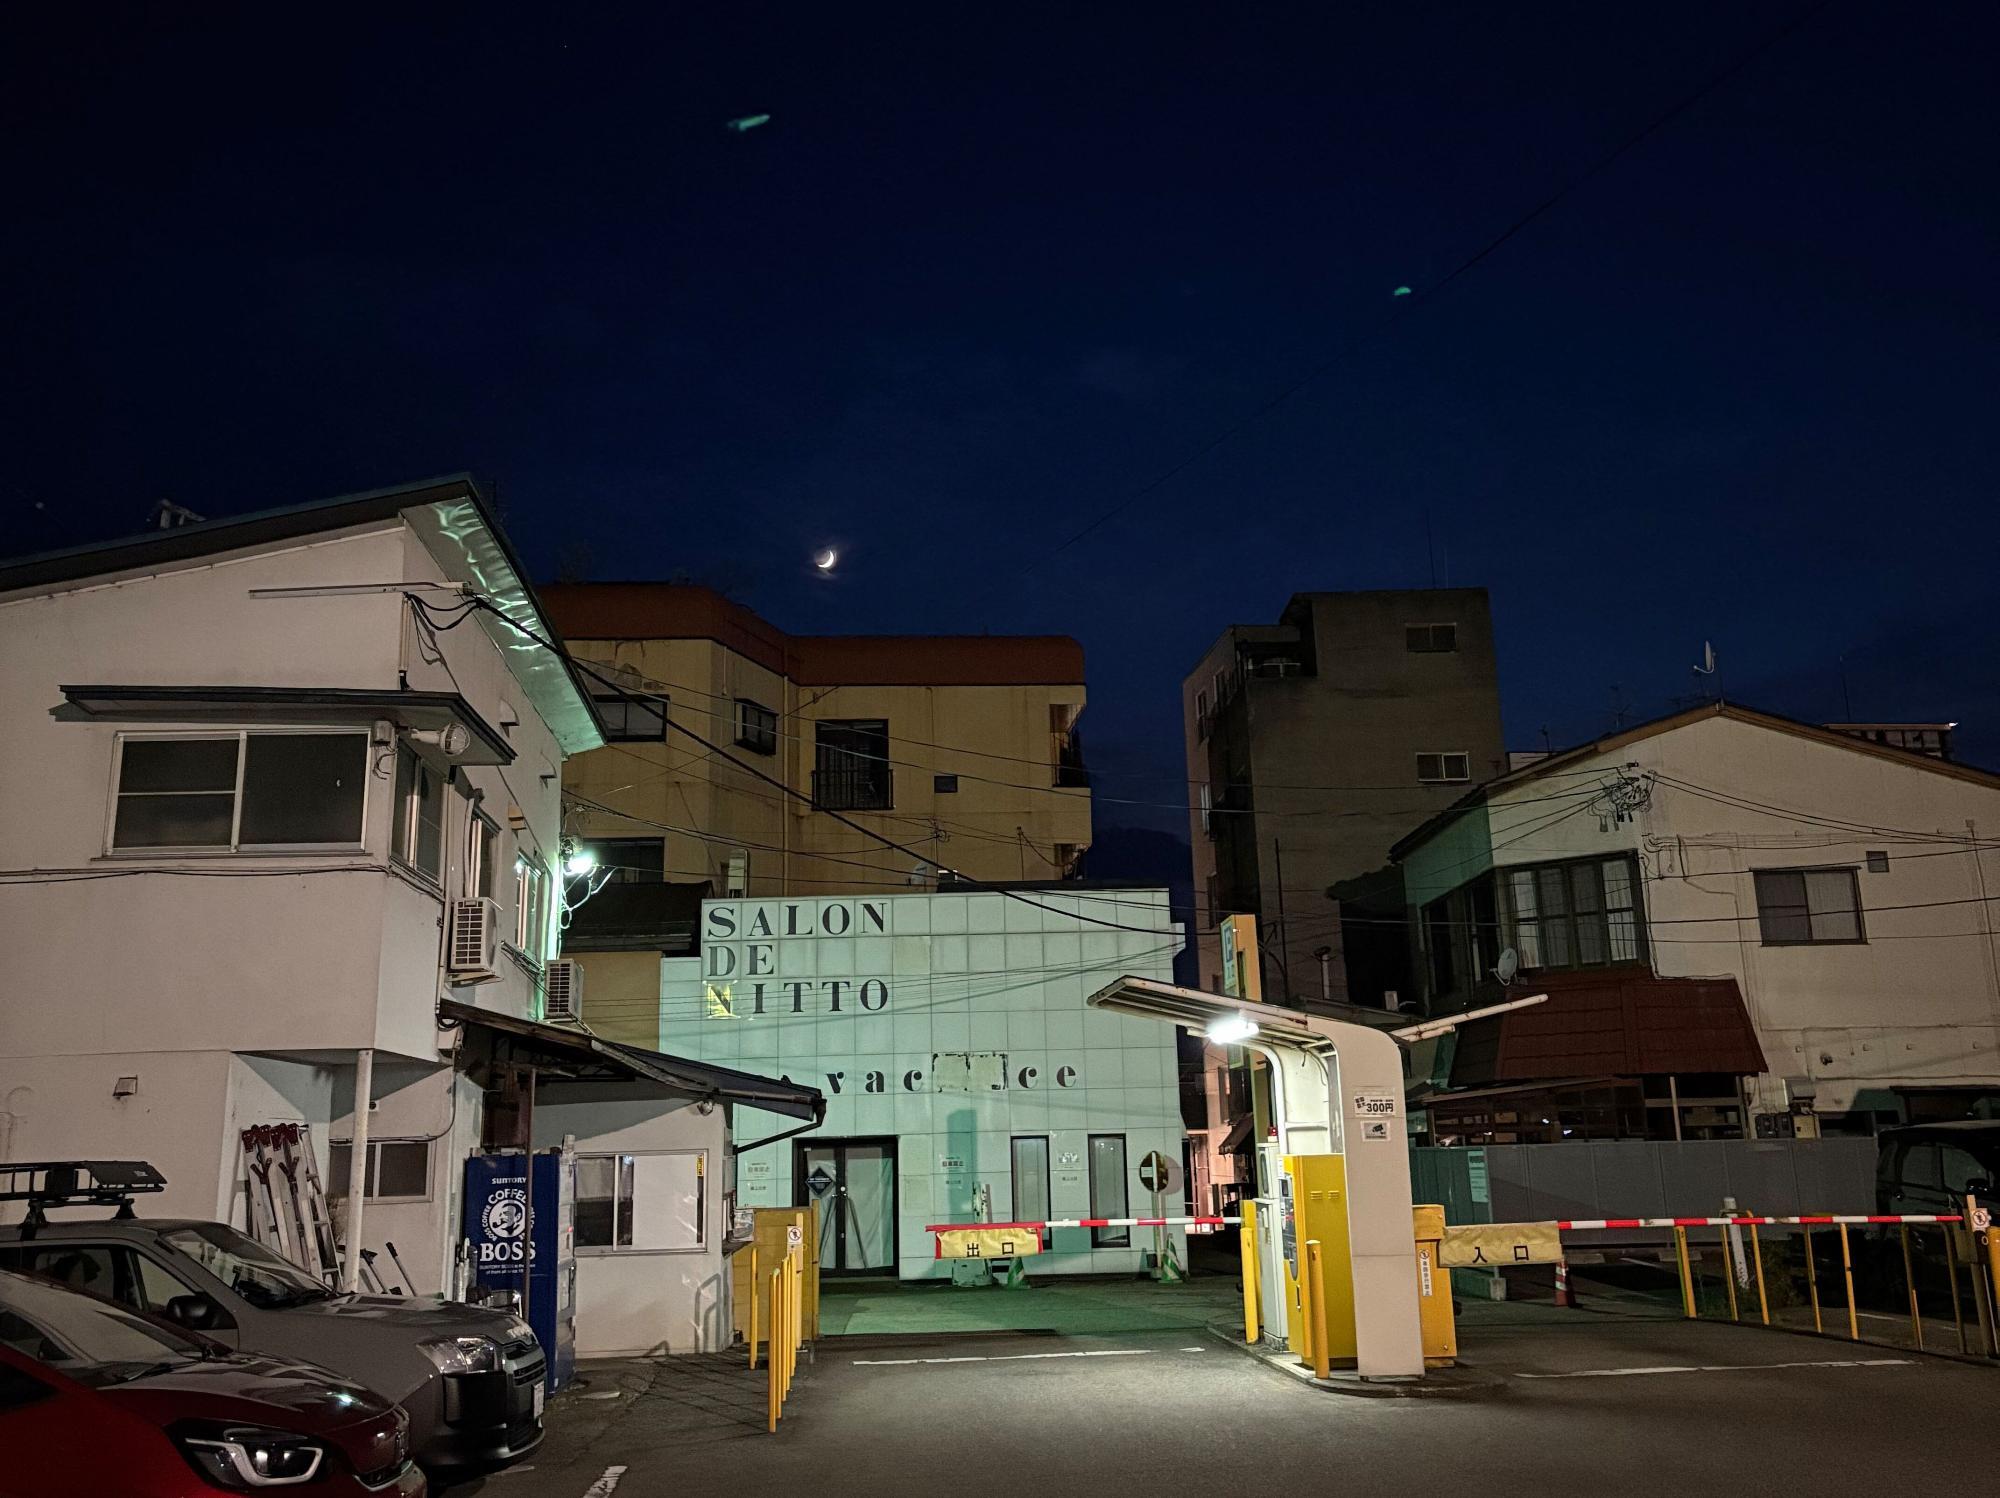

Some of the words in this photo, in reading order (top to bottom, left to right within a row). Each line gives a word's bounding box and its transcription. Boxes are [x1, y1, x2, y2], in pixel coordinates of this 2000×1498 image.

[707, 902, 888, 938] SALON
[707, 944, 775, 977] DE
[708, 978, 889, 1016] NITTO
[825, 1064, 1078, 1095] vacce
[1366, 1102, 1394, 1113] 300円
[491, 1177, 527, 1185] SUNTORY
[480, 1241, 536, 1262] BOSS
[967, 1242, 1014, 1257] 出口
[1472, 1245, 1530, 1263] 入口
